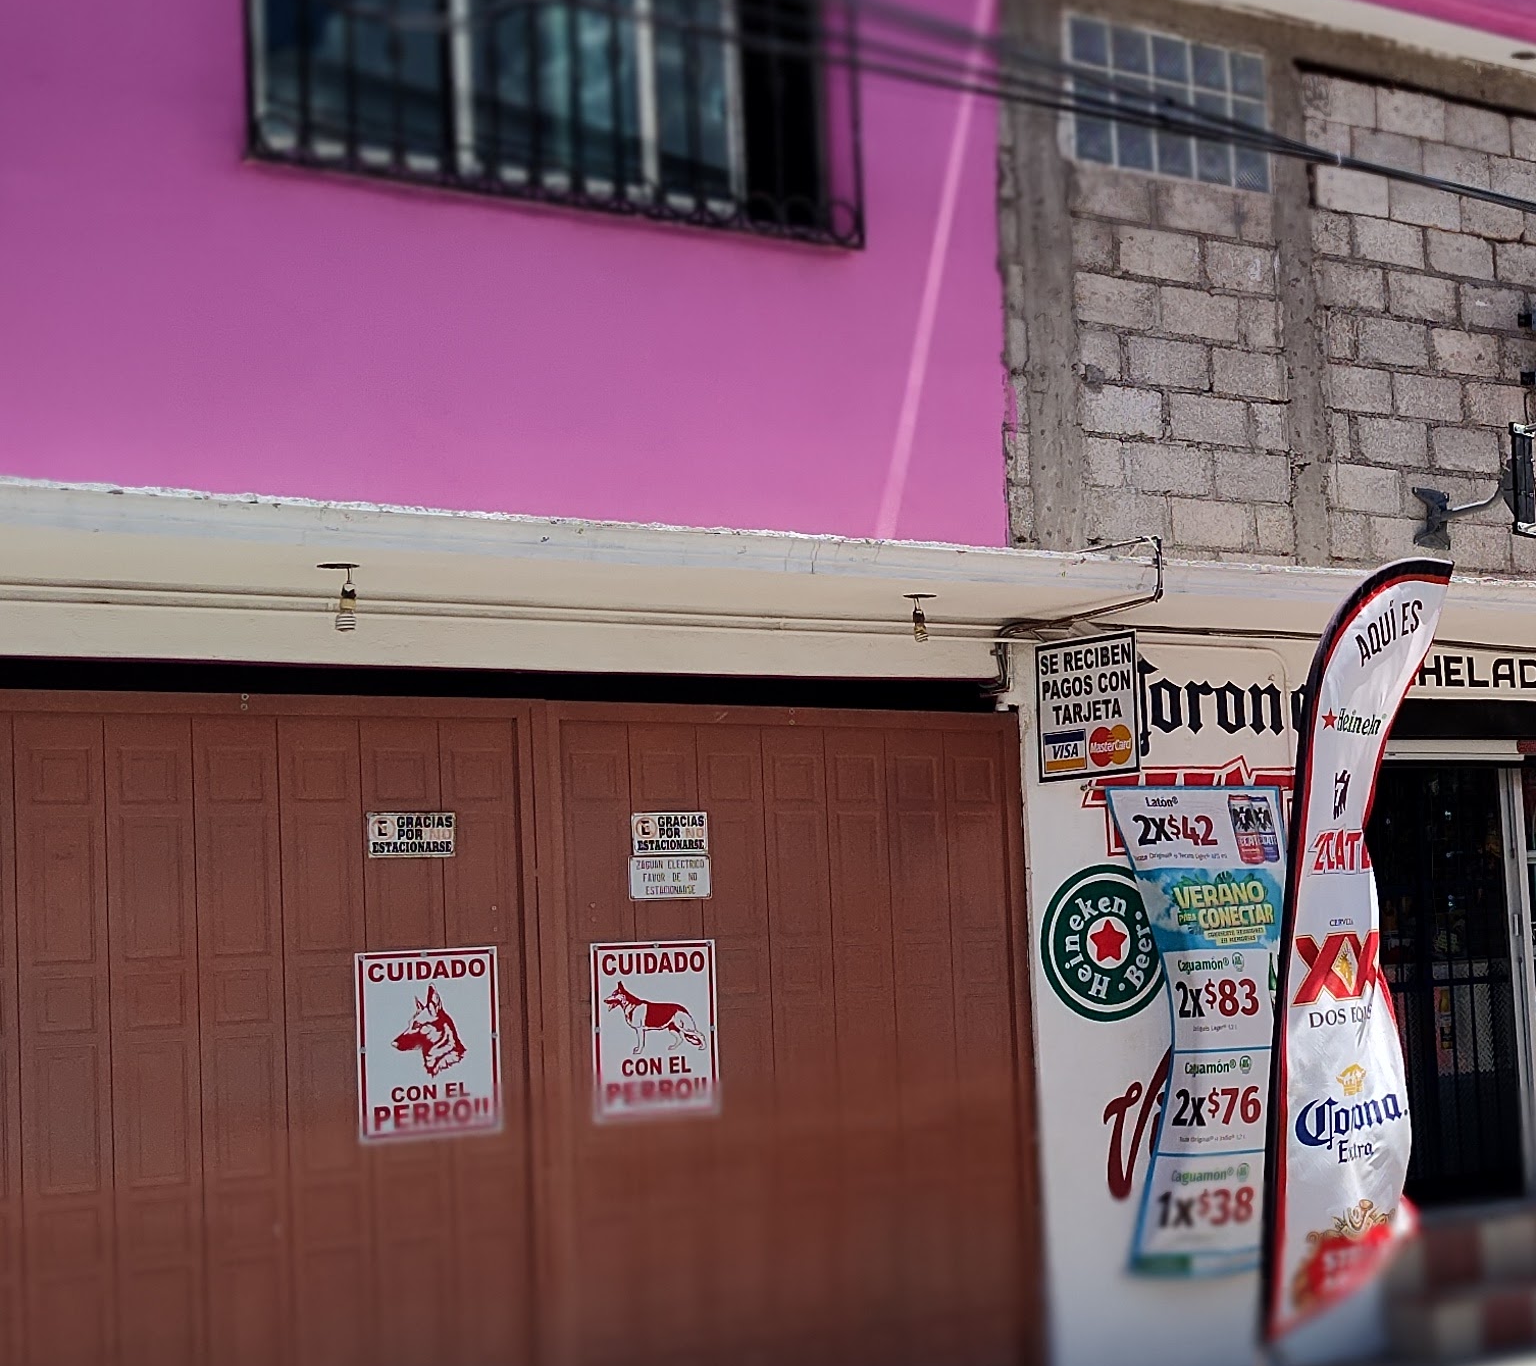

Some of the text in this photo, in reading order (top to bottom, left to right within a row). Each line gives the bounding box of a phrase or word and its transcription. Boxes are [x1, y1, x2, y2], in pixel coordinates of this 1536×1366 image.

[1355, 599, 1423, 667] AQUÍ ES
[1040, 642, 1131, 676] SE RECIBEN
[1042, 669, 1131, 701] PAGOS CON
[1052, 697, 1123, 726] TARJETA
[1052, 742, 1079, 760] VISA
[1090, 739, 1132, 754] MasterCard
[396, 816, 453, 829] GRACIAS
[657, 815, 705, 828] GRACIAS
[658, 828, 681, 839] POR
[397, 829, 423, 841] POR
[637, 839, 705, 851] ESTACIONARSE
[372, 841, 452, 854] ESTACIONARSE
[1173, 880, 1265, 910] VERANO
[1198, 904, 1275, 931] CONECTAR
[1065, 895, 1127, 1000] Heineken
[1123, 924, 1152, 991] Beer
[367, 957, 486, 983] CUIDADO
[601, 950, 705, 976] CUIDADO
[1309, 1008, 1346, 1028] DOS
[621, 1055, 692, 1078] CON EL
[391, 1082, 471, 1103] CON EL
[374, 1098, 490, 1133] PERRO!!
